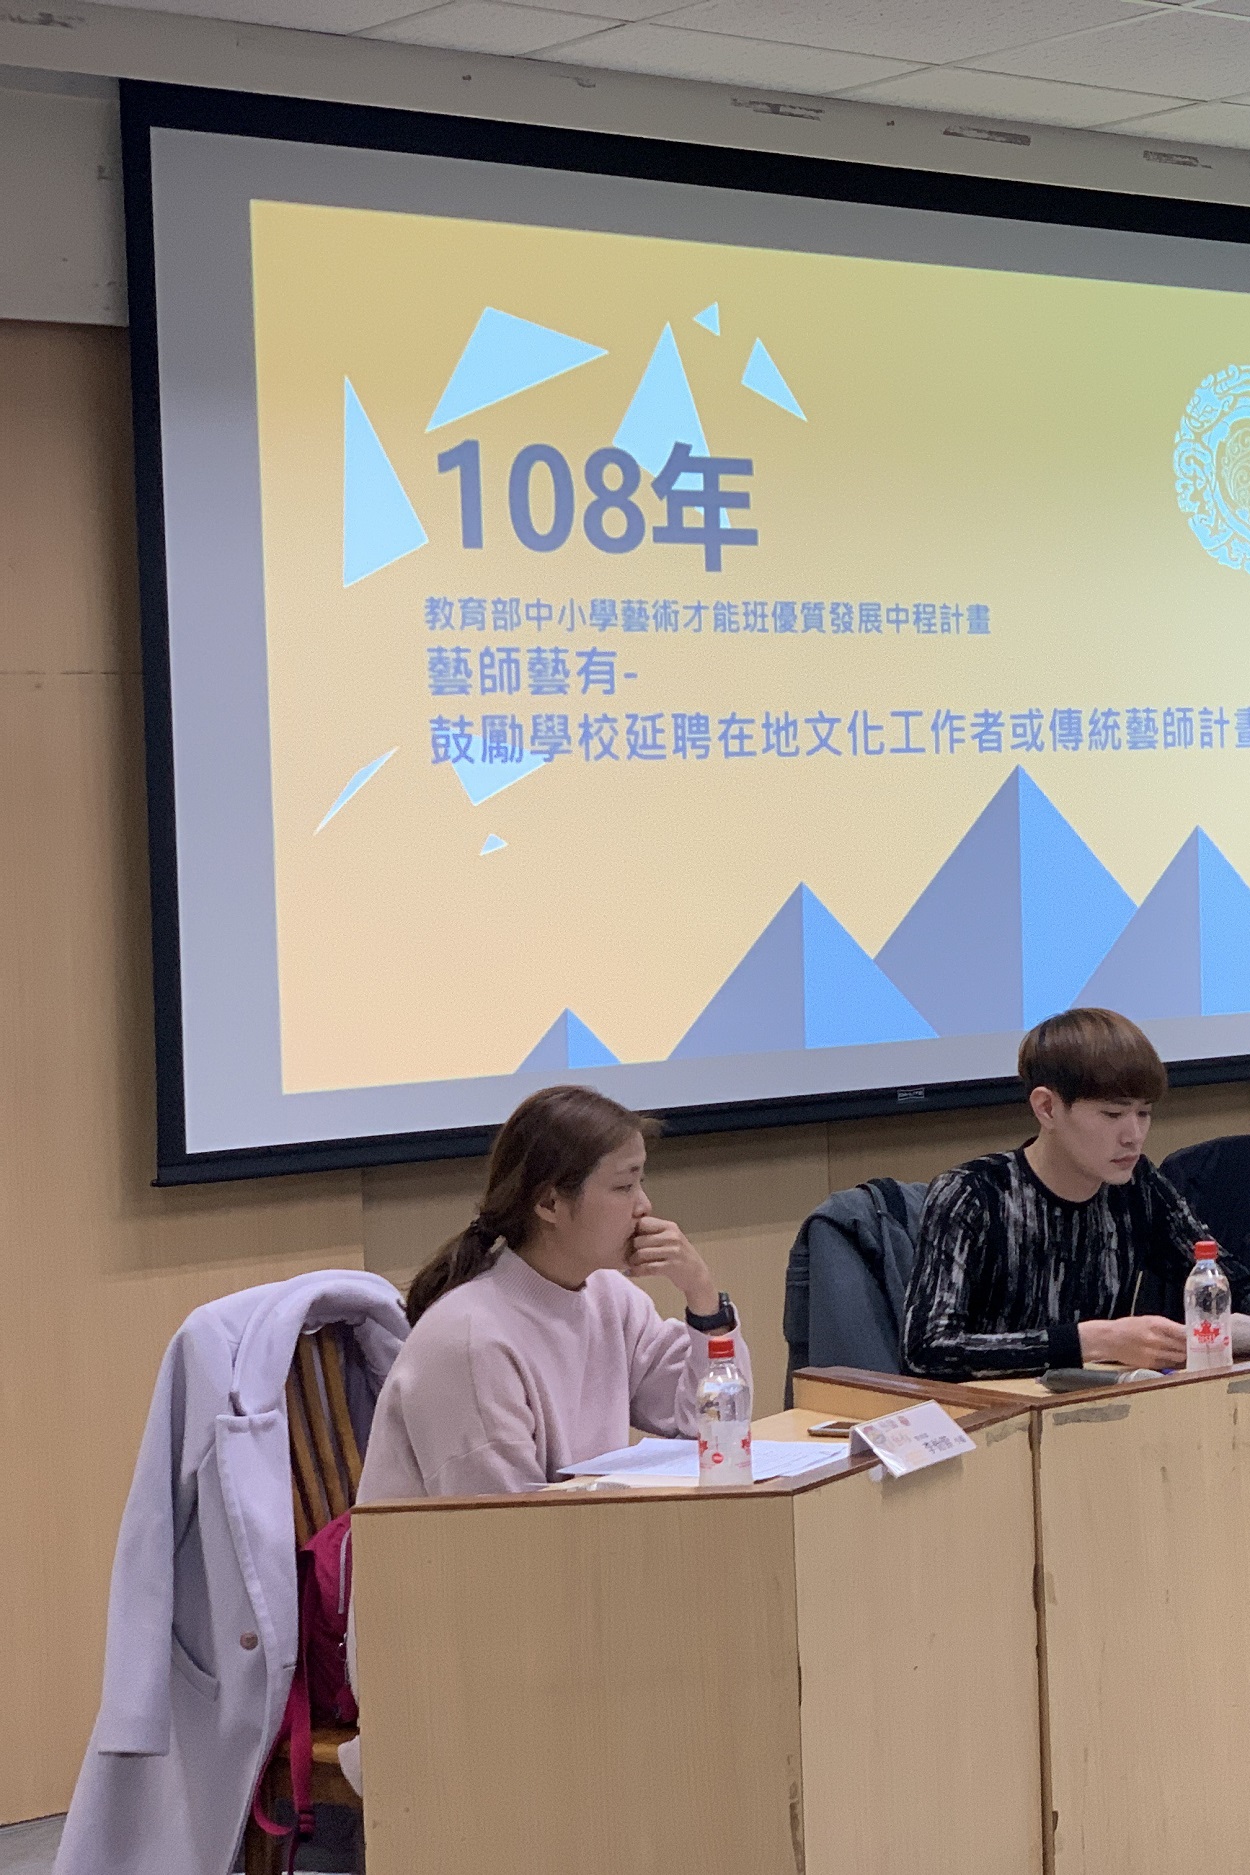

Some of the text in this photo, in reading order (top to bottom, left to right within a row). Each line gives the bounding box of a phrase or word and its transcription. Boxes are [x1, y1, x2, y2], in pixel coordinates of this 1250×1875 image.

[437, 439, 758, 572] 108年
[425, 596, 990, 635] 教育部中小學藝術才能班優質發展中程計畫
[427, 645, 638, 695] 藝師藝有-
